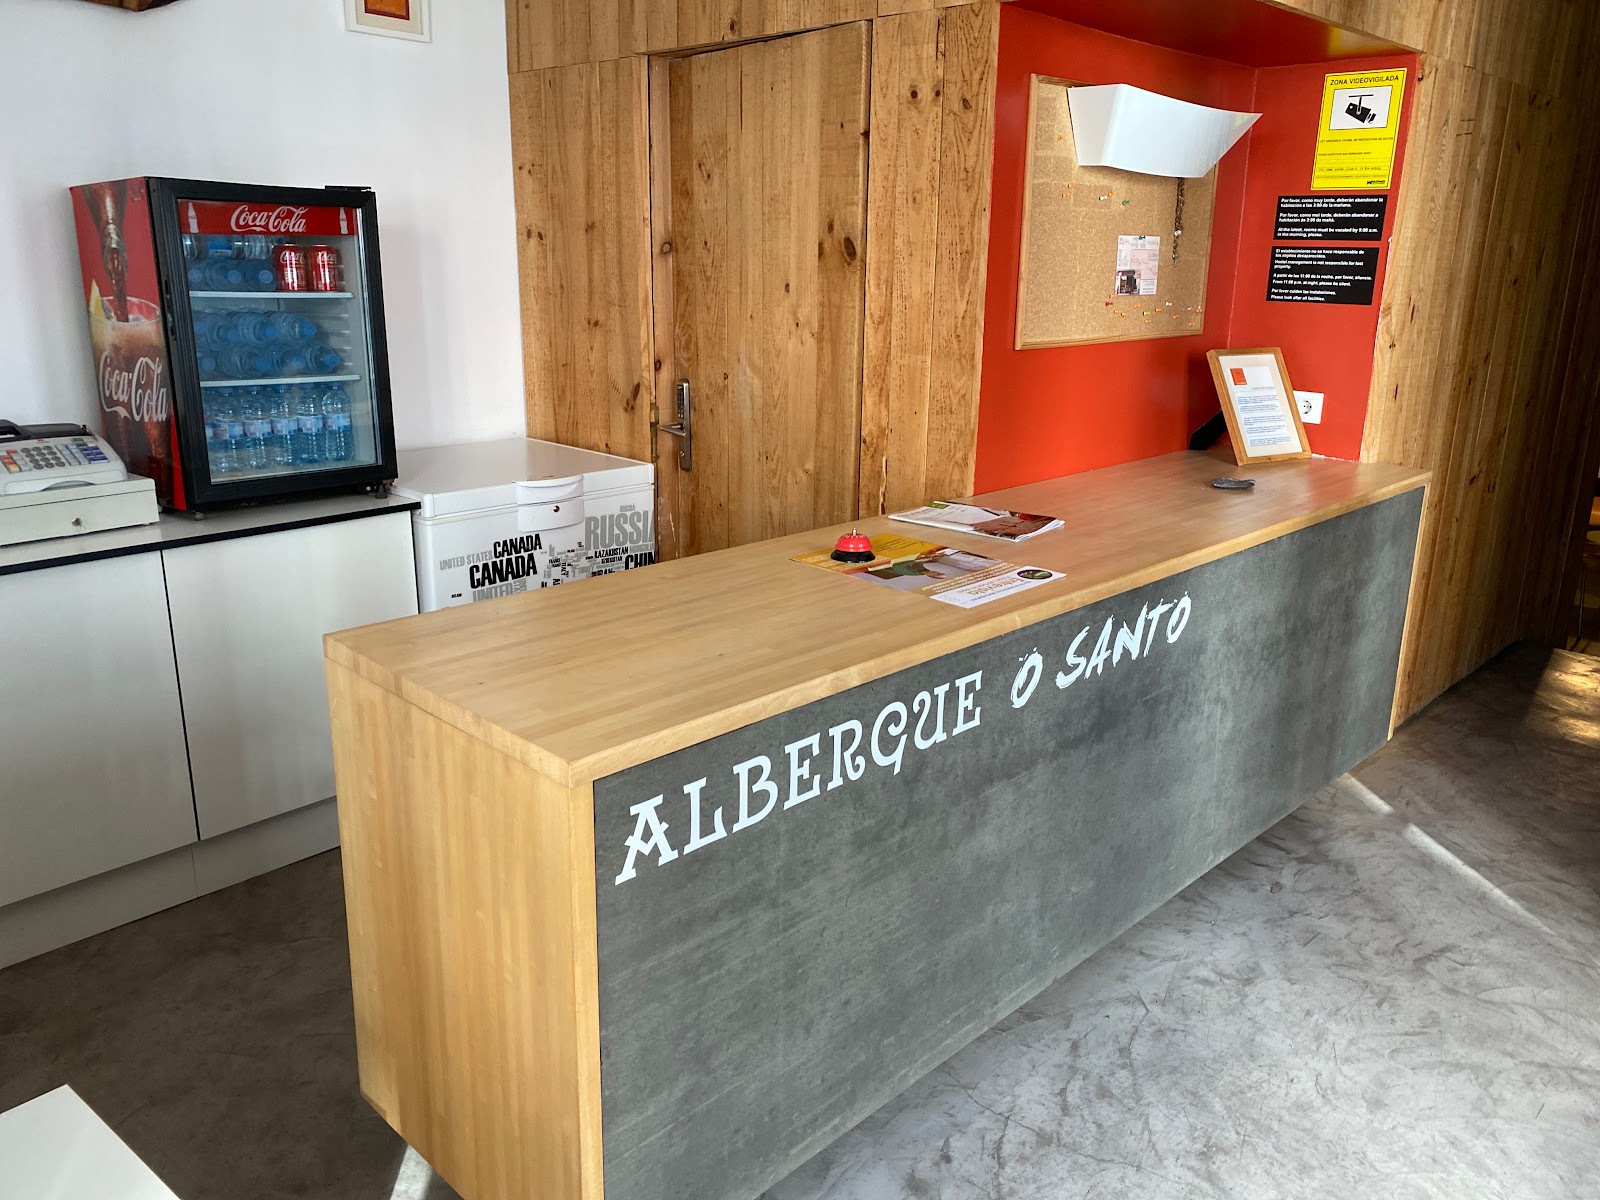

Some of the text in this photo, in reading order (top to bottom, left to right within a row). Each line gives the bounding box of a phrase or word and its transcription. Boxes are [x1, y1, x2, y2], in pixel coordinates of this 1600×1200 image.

[1350, 75, 1399, 84] VIDEOVIGILADA
[230, 205, 308, 232] Coca-Cola
[100, 350, 168, 422] Coca-Cola
[493, 533, 542, 559] CANADA
[440, 550, 493, 571] UNITED STATES
[469, 553, 538, 589] CANADA
[614, 670, 984, 886] ALBERGUE
[1055, 591, 1193, 689] SANTO
